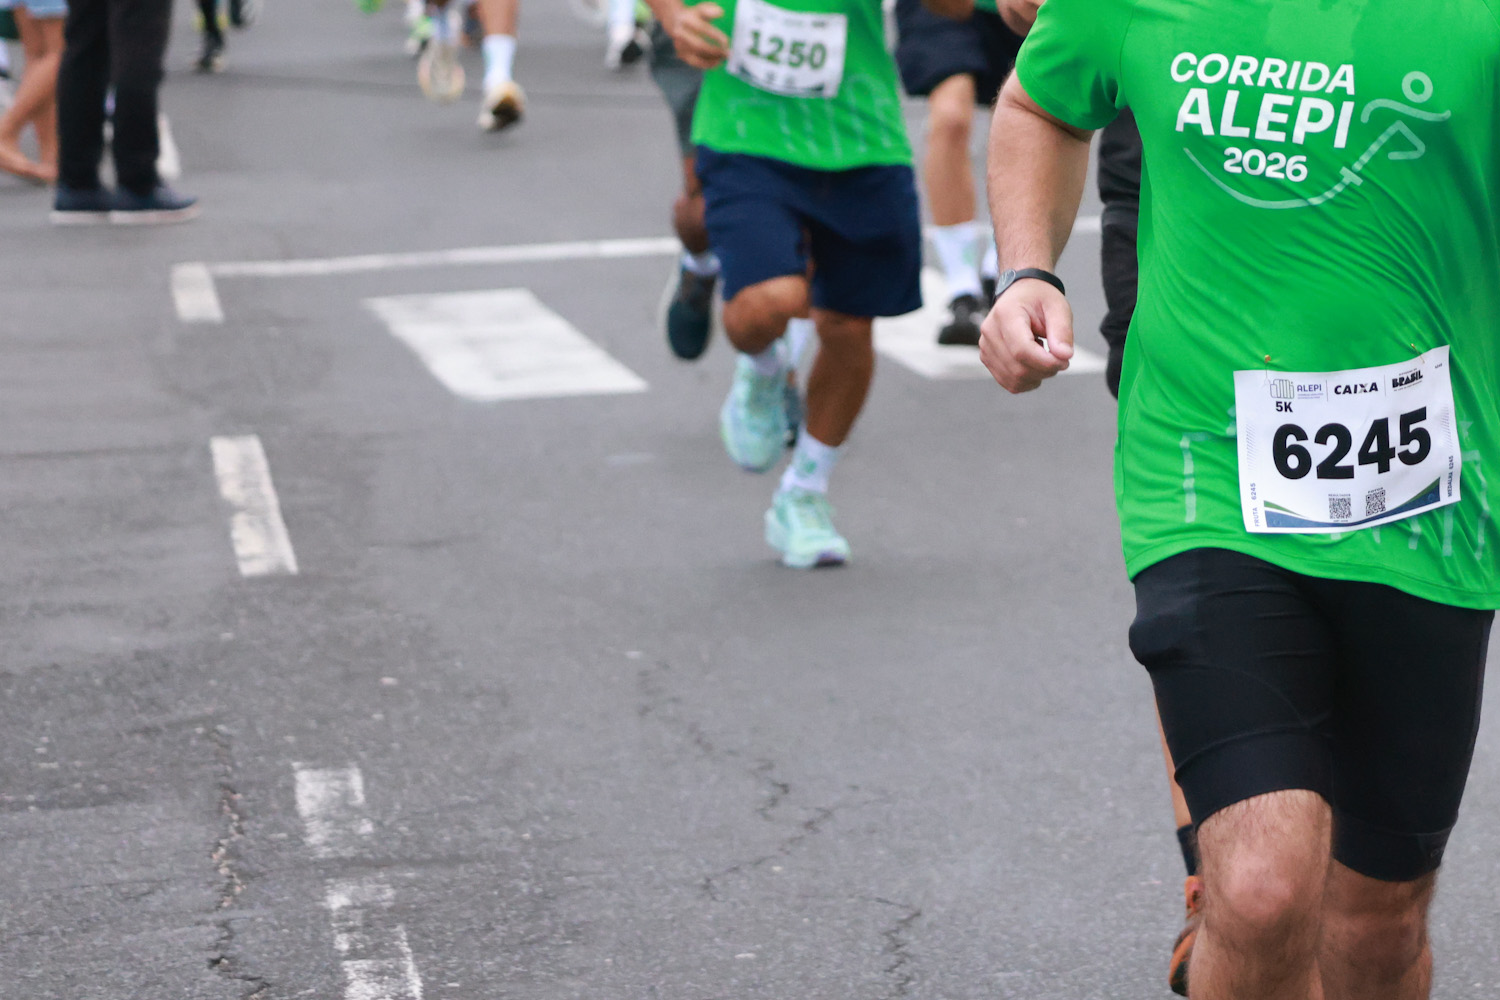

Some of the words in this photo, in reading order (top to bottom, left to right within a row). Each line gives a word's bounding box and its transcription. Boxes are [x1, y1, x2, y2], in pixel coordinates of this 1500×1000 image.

[748, 30, 828, 70] 1250
[1170, 52, 1355, 95] CORRIDA
[1175, 88, 1355, 148] ALEPI
[1223, 147, 1308, 182] 2026
[1297, 383, 1322, 392] ALEPI
[1334, 381, 1379, 395] CAIXA
[1392, 369, 1424, 388] BRASIL
[1275, 401, 1293, 413] 5K
[1272, 405, 1432, 480] 6245
[1252, 507, 1260, 527] FRUTA
